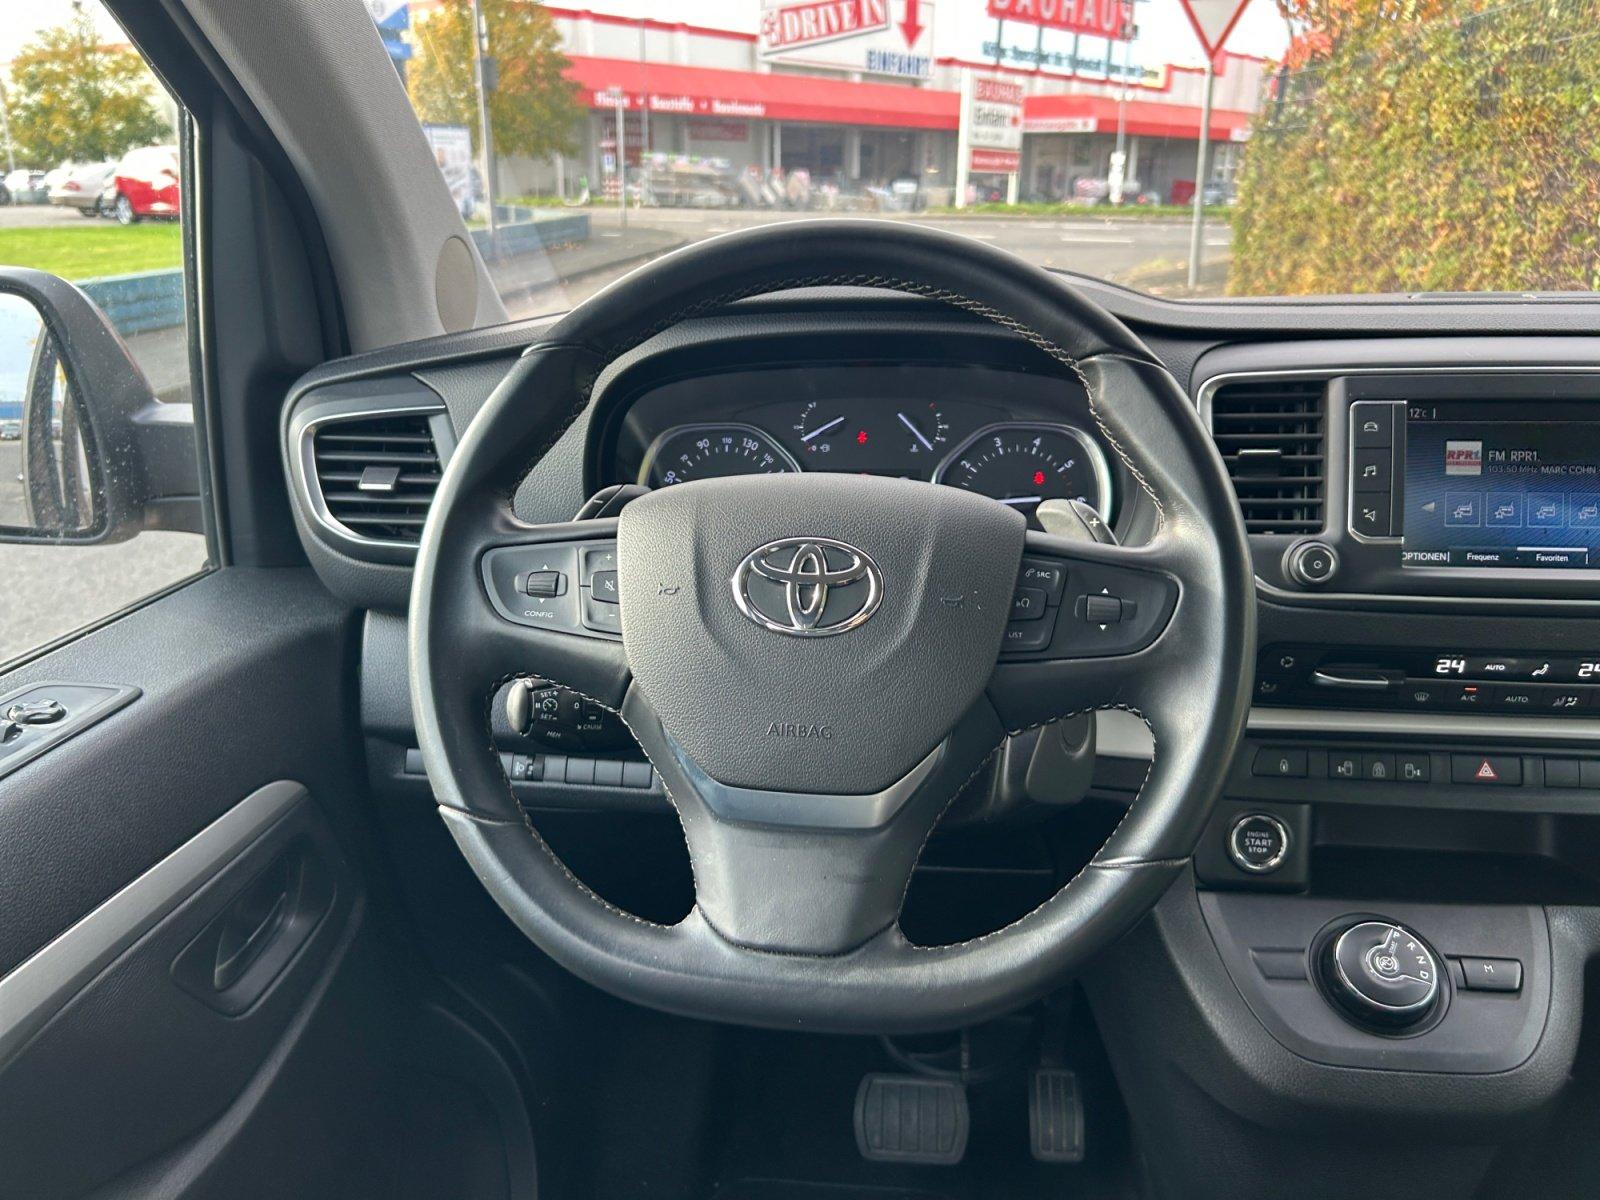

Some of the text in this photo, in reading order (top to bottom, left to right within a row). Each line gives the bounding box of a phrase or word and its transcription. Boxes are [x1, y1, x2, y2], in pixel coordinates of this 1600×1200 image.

[992, 0, 1134, 41] UHAUS
[696, 438, 710, 450] 90
[722, 436, 733, 444] 110
[743, 437, 759, 451] 130
[994, 437, 1002, 447] 3
[1032, 437, 1041, 447] 4
[1488, 450, 1505, 462] FM
[960, 459, 971, 470] 2
[1064, 459, 1075, 469] 5
[1541, 466, 1567, 475] MARC
[1568, 466, 1596, 475] COHN
[664, 470, 676, 484] 50
[1402, 551, 1446, 562] OPTIONEN
[1466, 552, 1499, 563] Frequenz
[1536, 553, 1568, 562] Favoriten
[1036, 571, 1050, 579] SRC
[524, 610, 554, 618] CONFIG
[1435, 659, 1466, 674] 24
[1460, 694, 1477, 702] A/C
[1505, 695, 1529, 703] AUTO
[767, 722, 832, 739] AIRBAG
[1245, 838, 1272, 847] START
[1406, 941, 1416, 950] R
[1416, 955, 1427, 964] N
[1483, 964, 1494, 974] M
[1419, 970, 1429, 980] D
